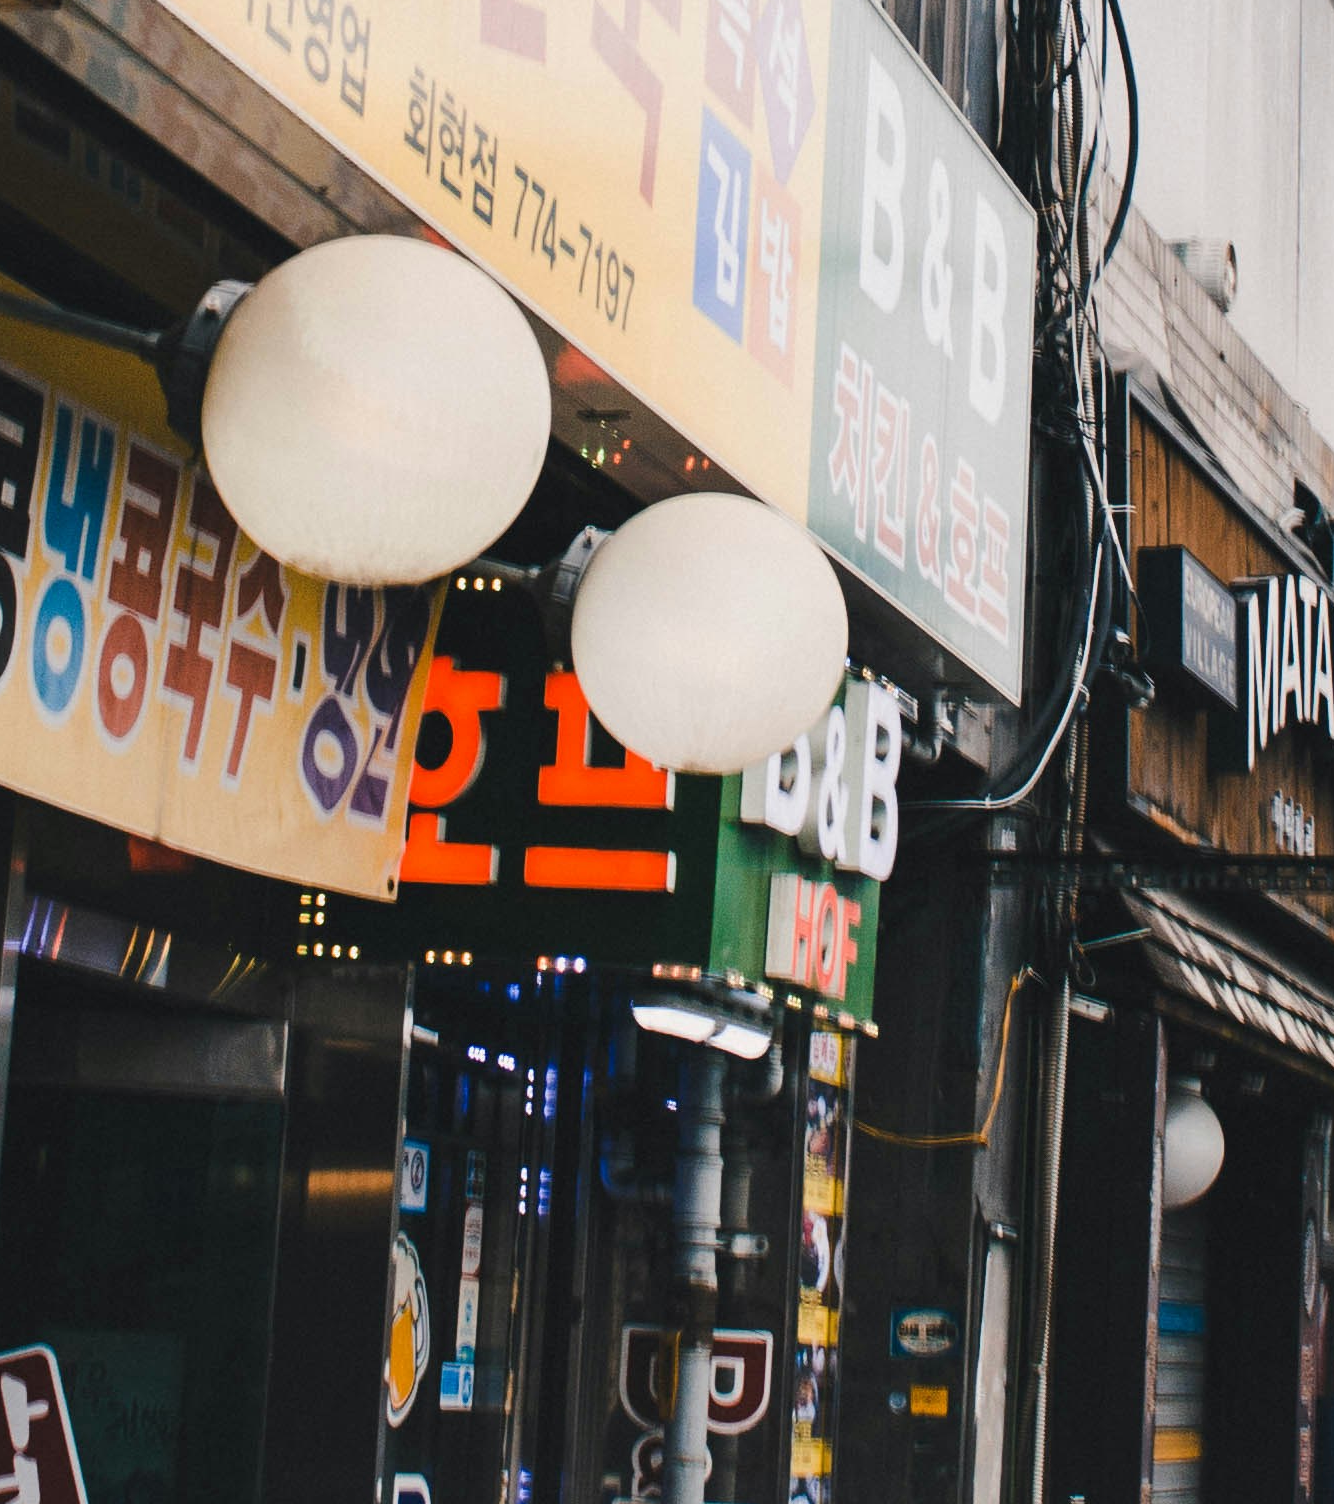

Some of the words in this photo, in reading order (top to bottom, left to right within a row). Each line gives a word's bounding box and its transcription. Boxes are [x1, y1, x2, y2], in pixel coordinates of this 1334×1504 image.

[403, 66, 499, 228] 회현점
[512, 166, 636, 332] 774-7197
[705, 138, 794, 357] 김밥
[765, 870, 862, 1002] HOF
